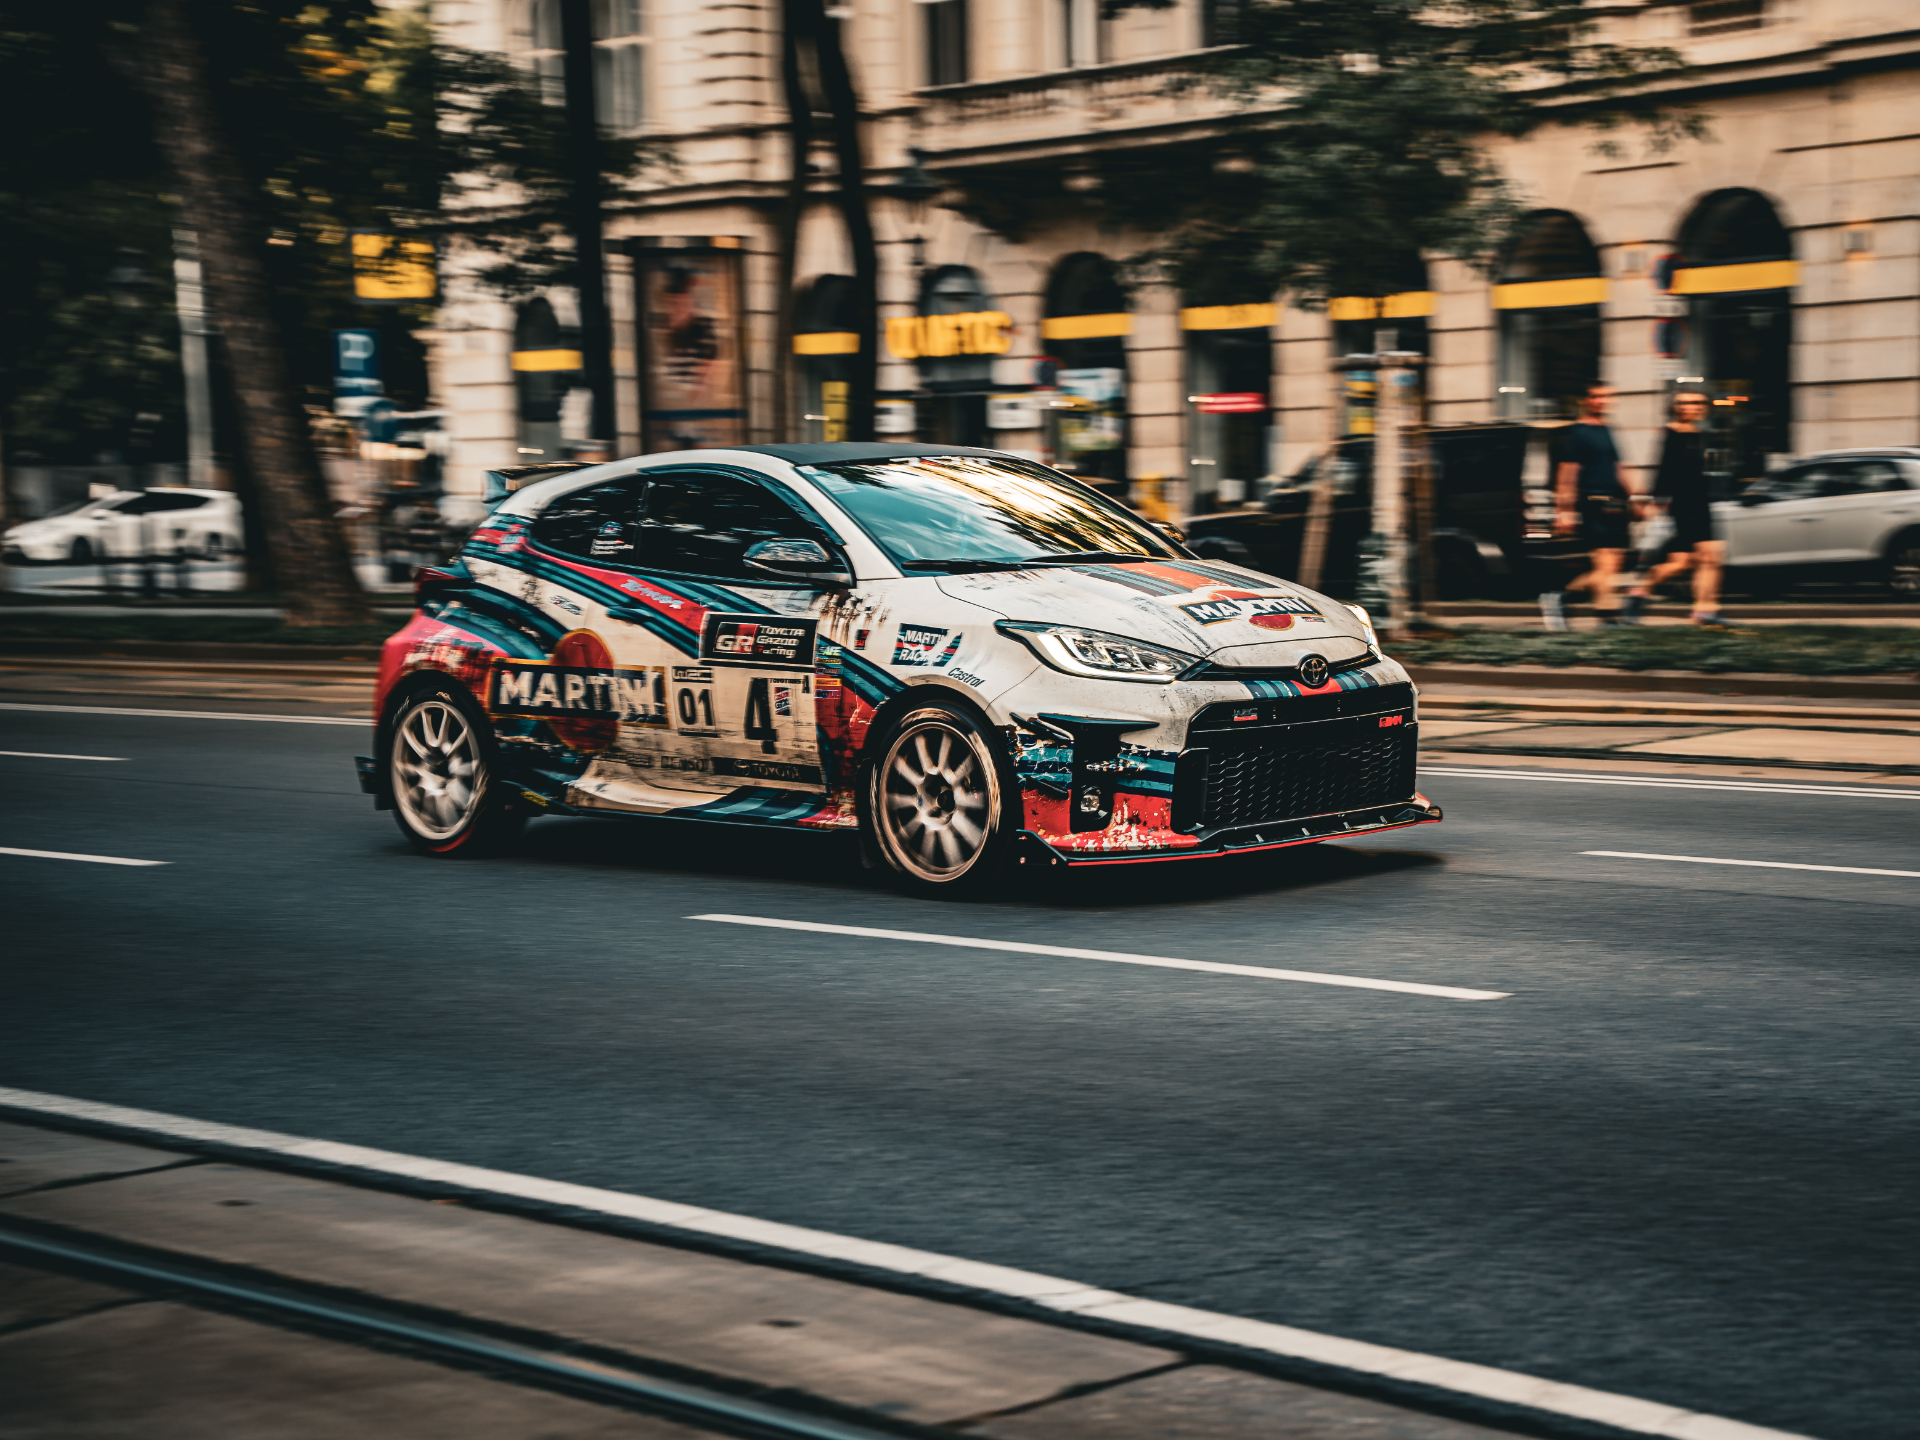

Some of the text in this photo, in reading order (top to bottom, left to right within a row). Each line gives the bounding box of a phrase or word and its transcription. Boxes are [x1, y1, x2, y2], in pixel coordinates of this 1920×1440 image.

[759, 625, 805, 637] TOYOTA
[715, 635, 753, 652] GR
[947, 667, 986, 687] Castrol
[678, 688, 716, 726] 01
